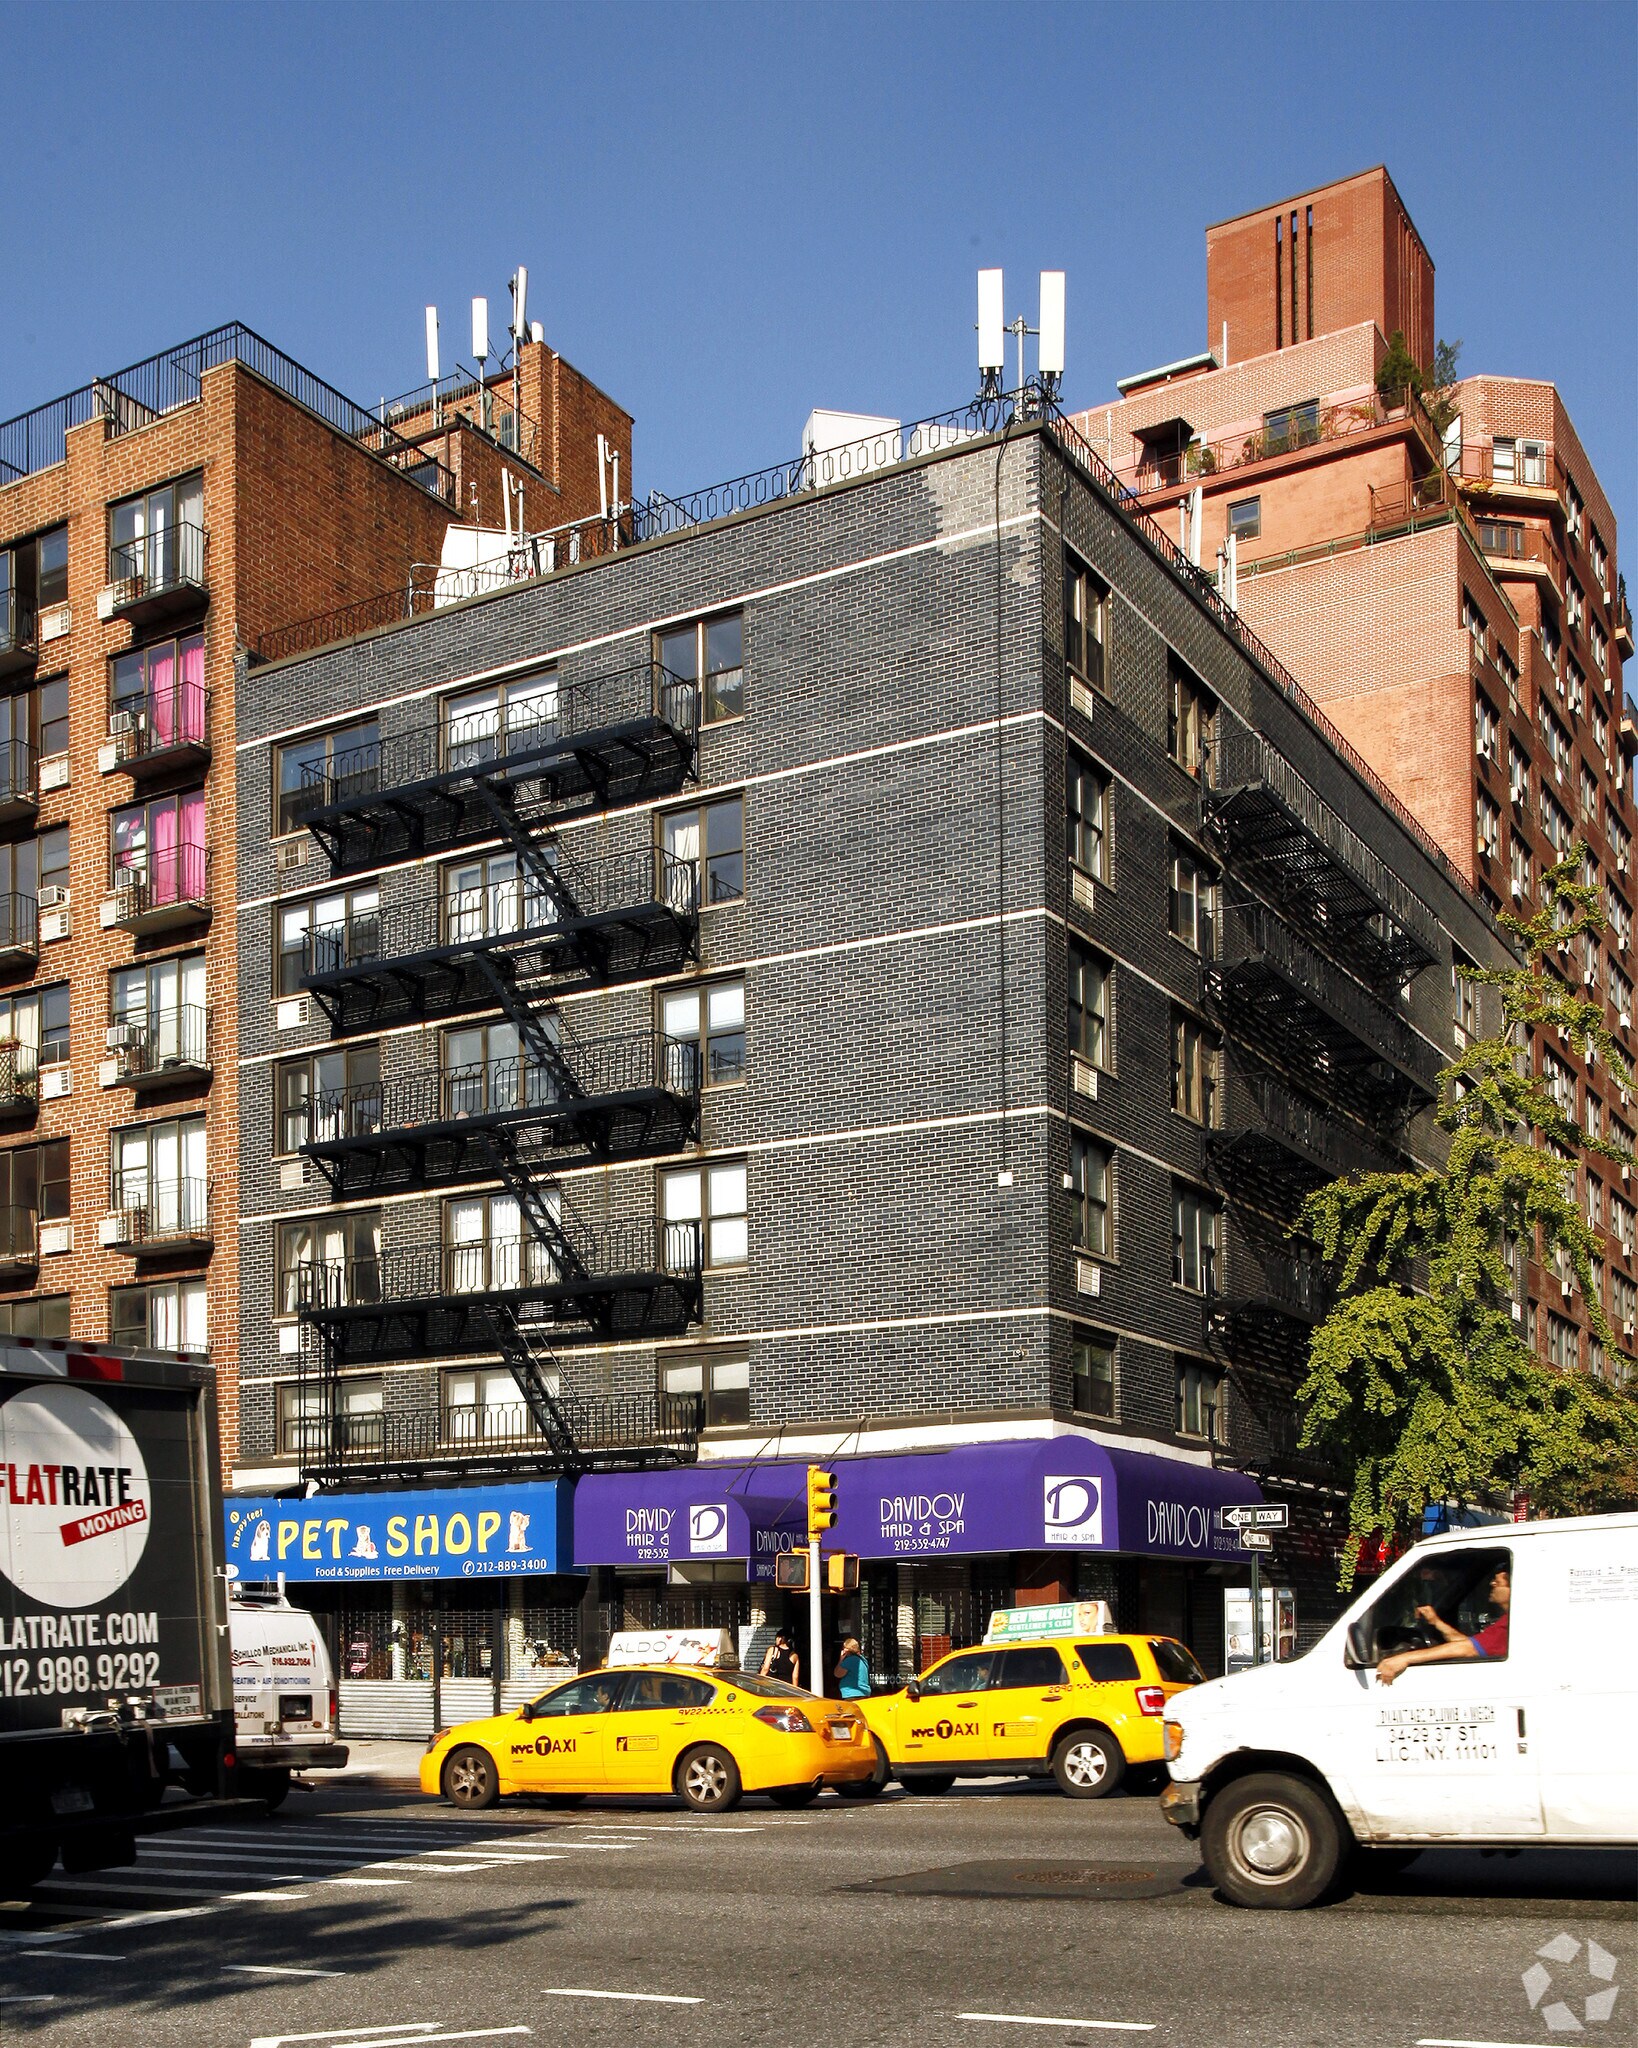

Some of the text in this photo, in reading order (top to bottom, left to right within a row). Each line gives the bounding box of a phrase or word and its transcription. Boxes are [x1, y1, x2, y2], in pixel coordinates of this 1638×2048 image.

[880, 1493, 964, 1522] DAVIDOV
[78, 1503, 144, 1537] MOVING
[1147, 1500, 1210, 1548] DAVIDOV
[1231, 1511, 1278, 1522] ONE WAY
[277, 1510, 501, 1560] PET SHOP
[881, 1520, 965, 1537] HAIR & SPA
[627, 1533, 655, 1546] HAIR
[894, 1537, 950, 1551] 212-532-4747
[1051, 1533, 1067, 1542] HAIR
[1081, 1533, 1095, 1542] SPA
[1245, 1534, 1254, 1543] ONE
[315, 1564, 440, 1578] Food & Supplies Free Delivery
[476, 1559, 547, 1573] 212-889-3400
[1009, 1611, 1027, 1624] NEW
[1049, 1606, 1074, 1621] DOLLS
[613, 1641, 667, 1653] ALDO
[0, 1651, 160, 1697] 12.988.9292
[233, 1677, 311, 1685] HEATING AIR CONDITIONING
[911, 1720, 979, 1739] NYC TAXI
[1390, 1726, 1481, 1743] 34-29 37 ST.
[511, 1735, 576, 1756] NYC TAXI
[1456, 1744, 1497, 1760] 11101
